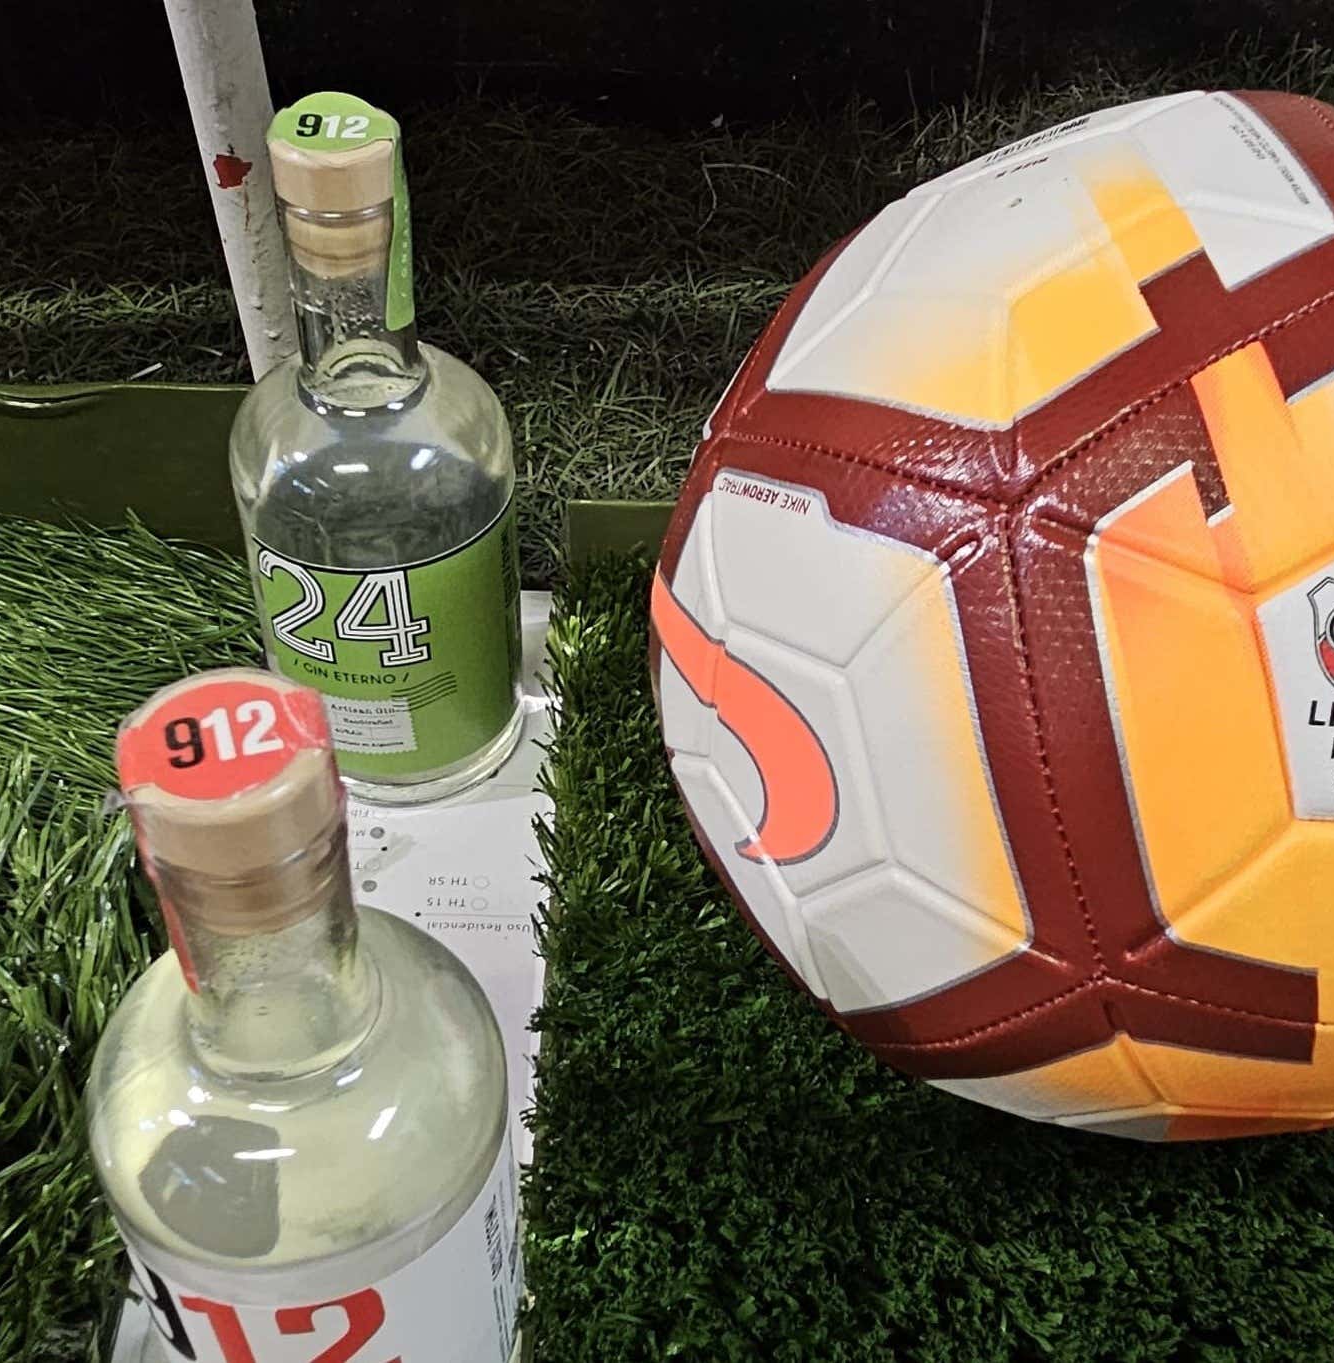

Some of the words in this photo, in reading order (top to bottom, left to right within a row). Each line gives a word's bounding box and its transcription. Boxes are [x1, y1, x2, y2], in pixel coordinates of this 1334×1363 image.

[296, 113, 370, 140] 912
[780, 493, 811, 516] NIKE
[259, 548, 431, 668] 24
[303, 663, 329, 680] GIN
[334, 672, 396, 685] ETERNO
[164, 699, 284, 769] 912
[450, 877, 468, 887] TH
[448, 899, 466, 909] TH
[427, 921, 502, 933] Residencial
[506, 922, 531, 934] Uso
